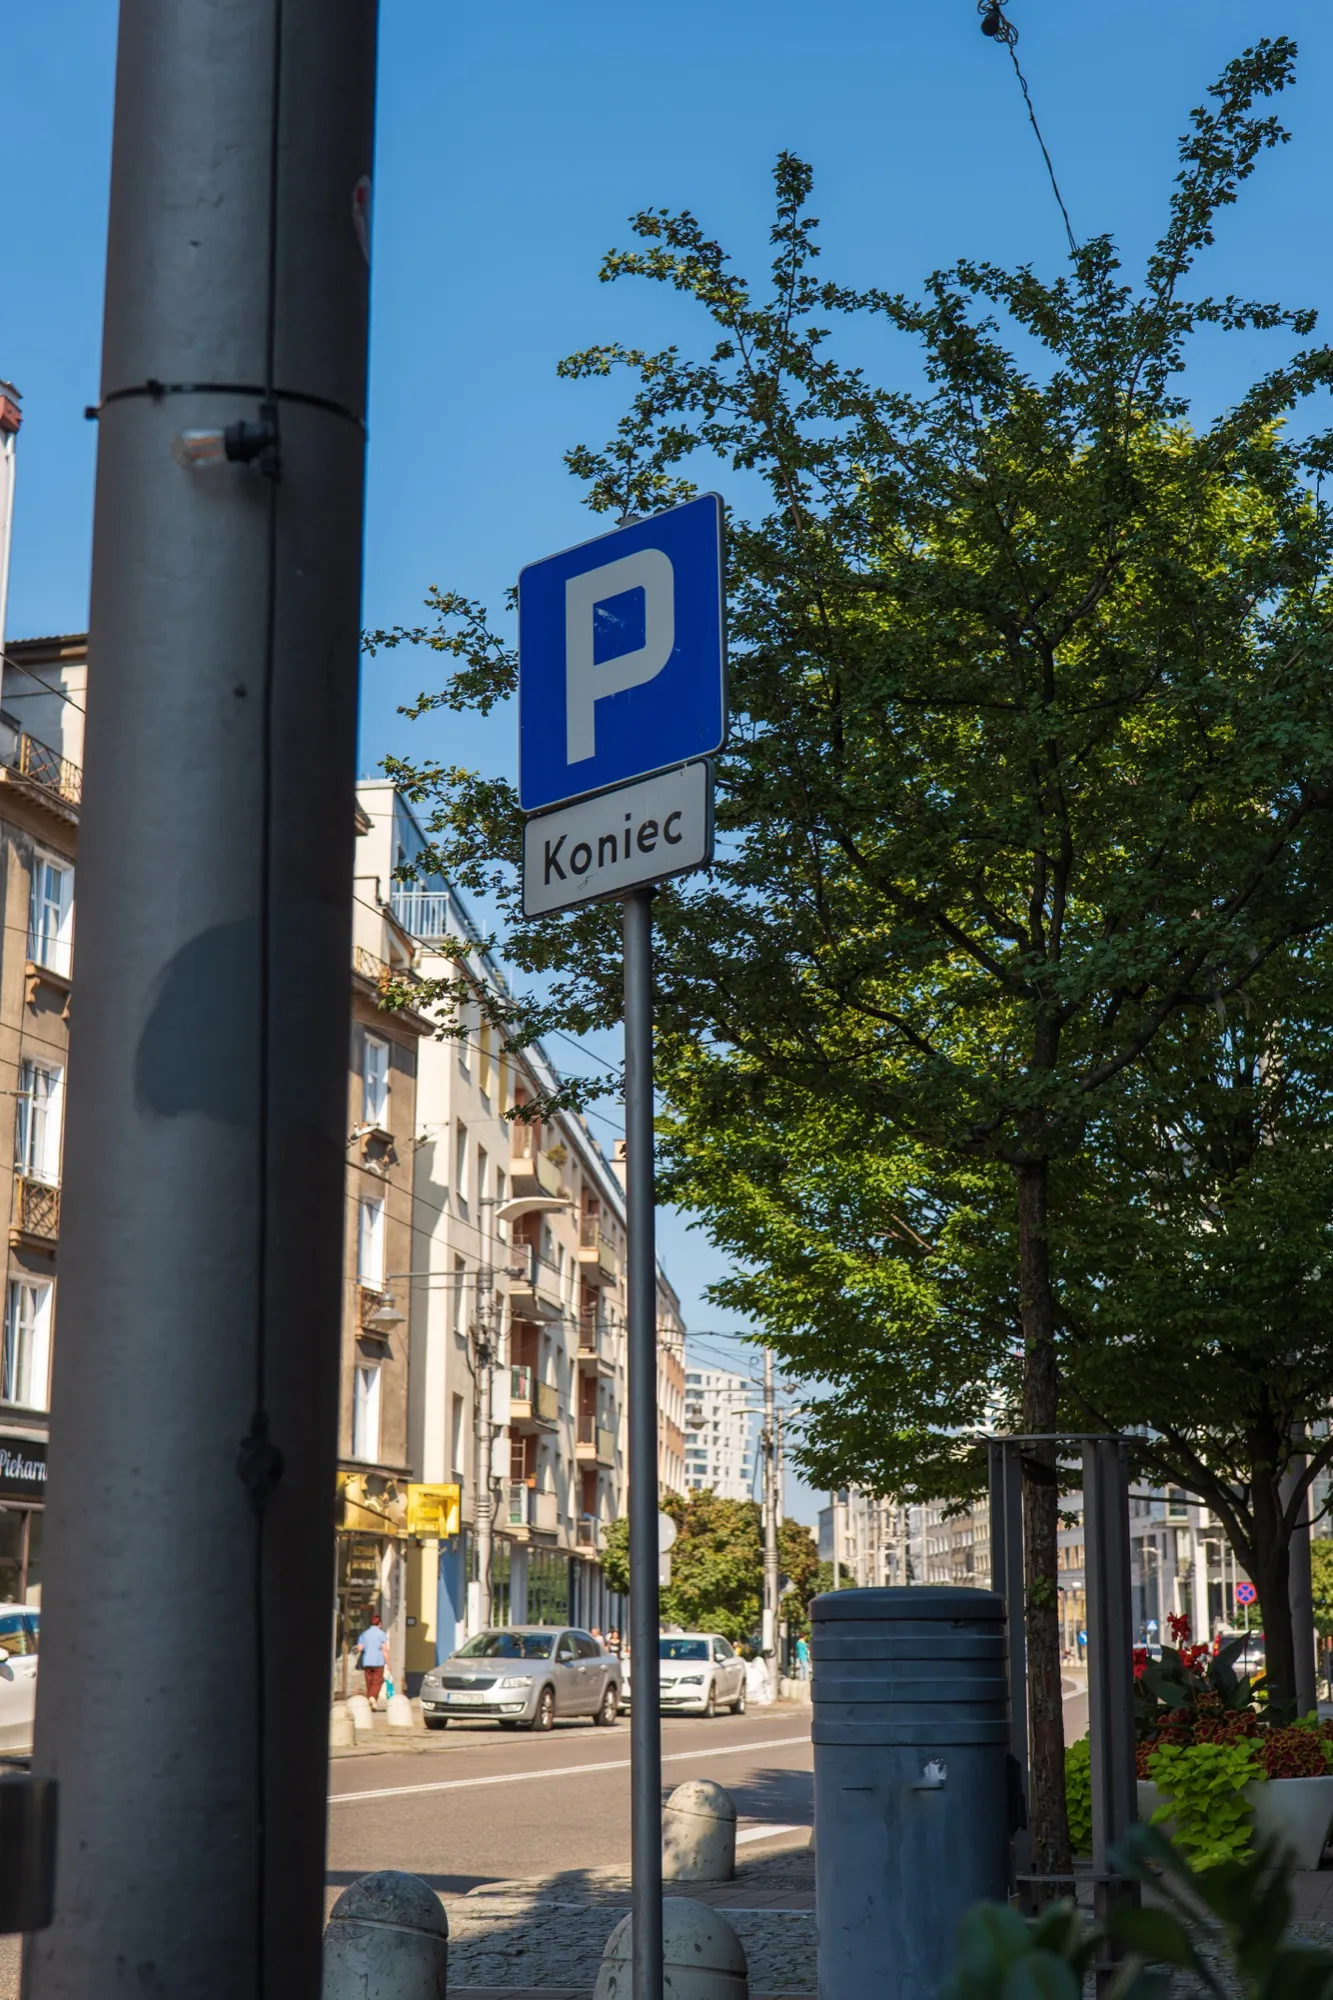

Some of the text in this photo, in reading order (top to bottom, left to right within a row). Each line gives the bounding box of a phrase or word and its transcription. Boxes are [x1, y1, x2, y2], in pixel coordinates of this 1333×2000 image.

[565, 548, 675, 766] P
[544, 811, 683, 886] Koniec
[0, 1448, 48, 1482] Piekarn
